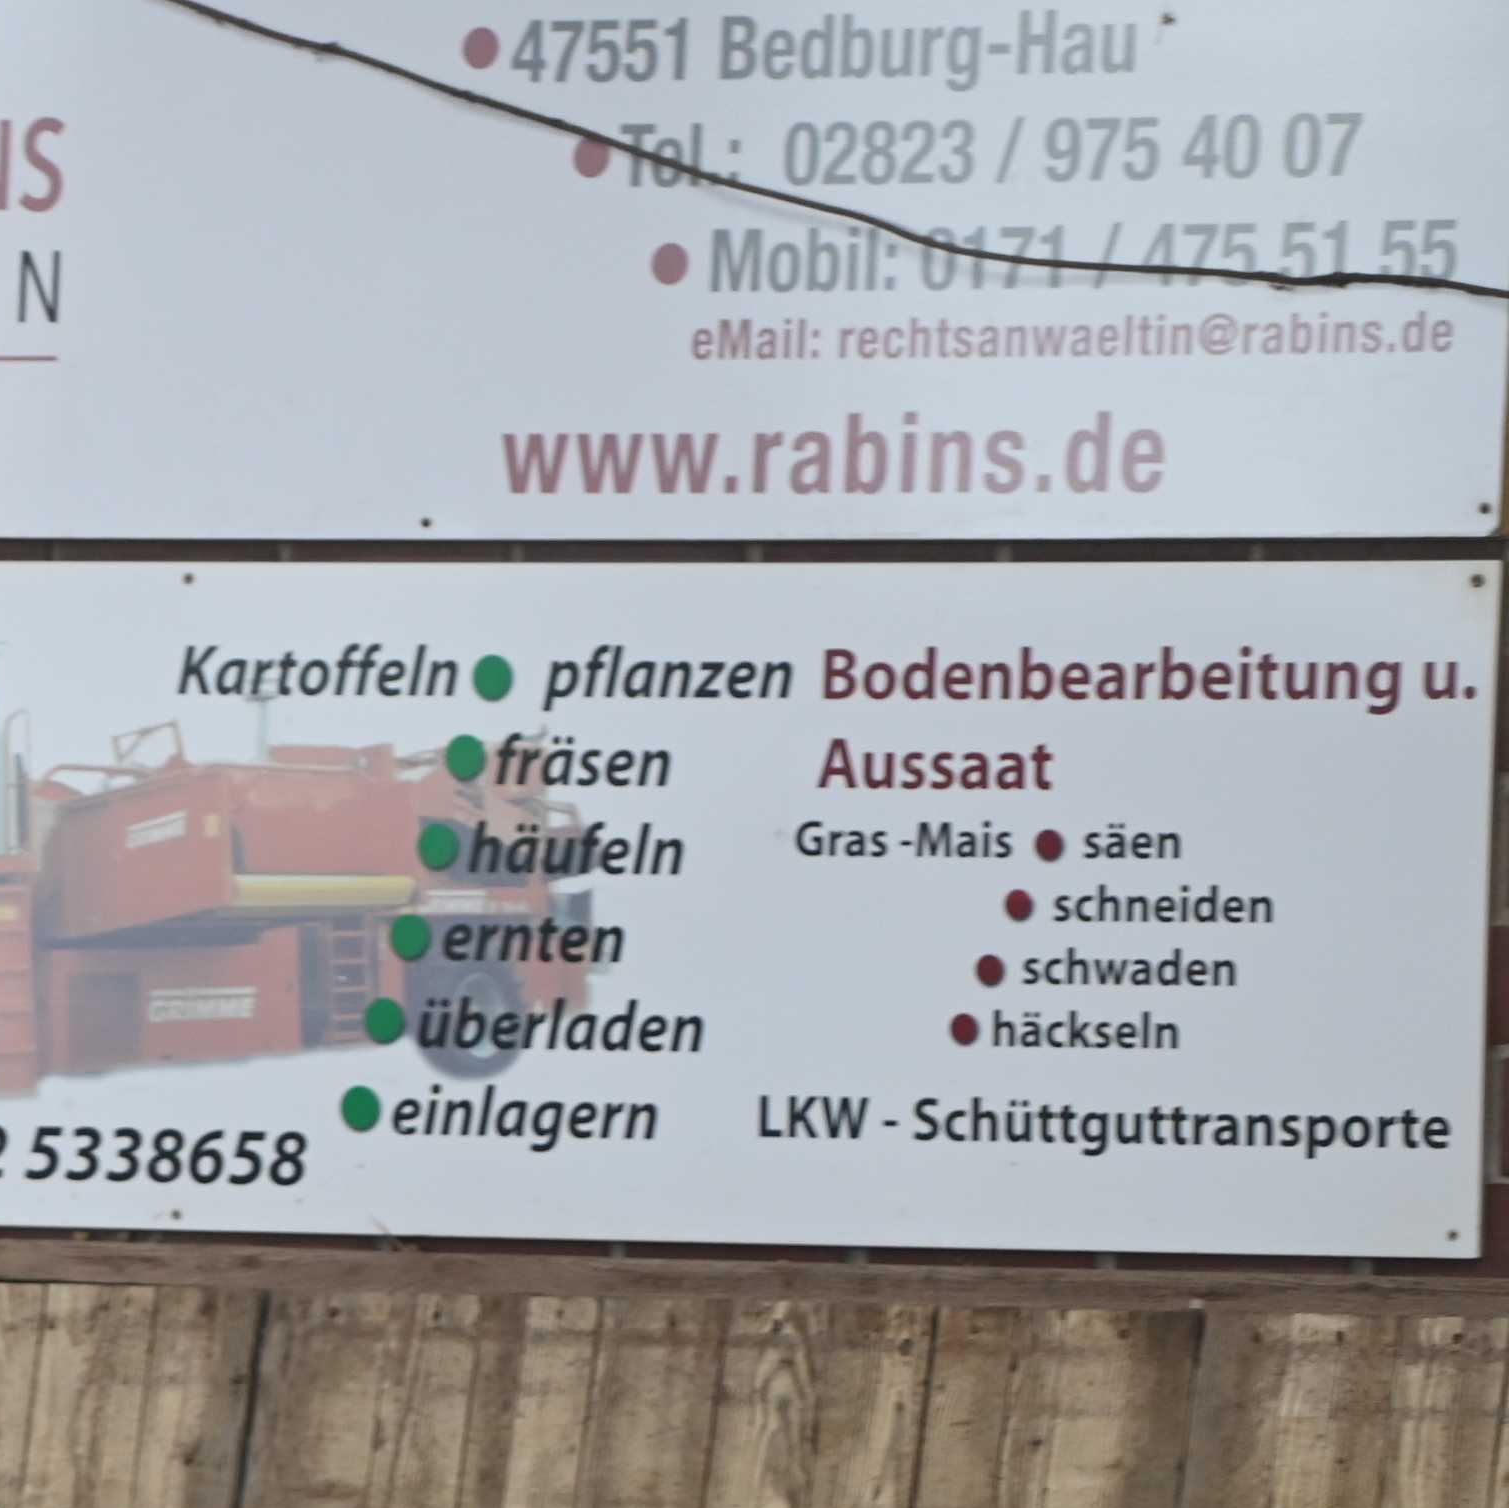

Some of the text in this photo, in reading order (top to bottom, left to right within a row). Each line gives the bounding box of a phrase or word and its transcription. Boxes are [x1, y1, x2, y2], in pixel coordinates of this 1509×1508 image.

[511, 11, 1138, 92] 47551 Bedburg-Hau
[782, 118, 977, 187] 02823
[1043, 115, 1162, 183] 975
[1183, 113, 1262, 181] 40
[1282, 112, 1365, 178] 07
[709, 227, 899, 292] Mobil:
[920, 225, 1065, 291] 0171
[1142, 222, 1258, 288] 475
[1279, 220, 1349, 287] 51
[1379, 219, 1459, 287] 55
[692, 311, 1454, 360] eMail: rechtsanwaeltin@rabins.de
[501, 412, 1165, 494] www.rabins.de
[177, 642, 794, 710] Kartoffeln pflanzen
[821, 646, 1477, 715] Bodenbearbeitung u.
[495, 731, 672, 788] fräsen
[817, 738, 1054, 791] Aussaat
[468, 821, 685, 877] häufeln
[795, 822, 888, 858] Gras
[1082, 824, 1182, 859] säen
[1052, 885, 1274, 923] schneiden
[442, 914, 625, 963] ernten
[1021, 949, 1238, 987] schwaden
[418, 998, 704, 1054] überladen
[991, 1011, 1179, 1050] häckseln
[392, 1087, 658, 1151] einlagern
[757, 1095, 869, 1139] LKW
[912, 1098, 1452, 1159] Schüttguttransporte
[26, 1124, 308, 1186] 5338658
